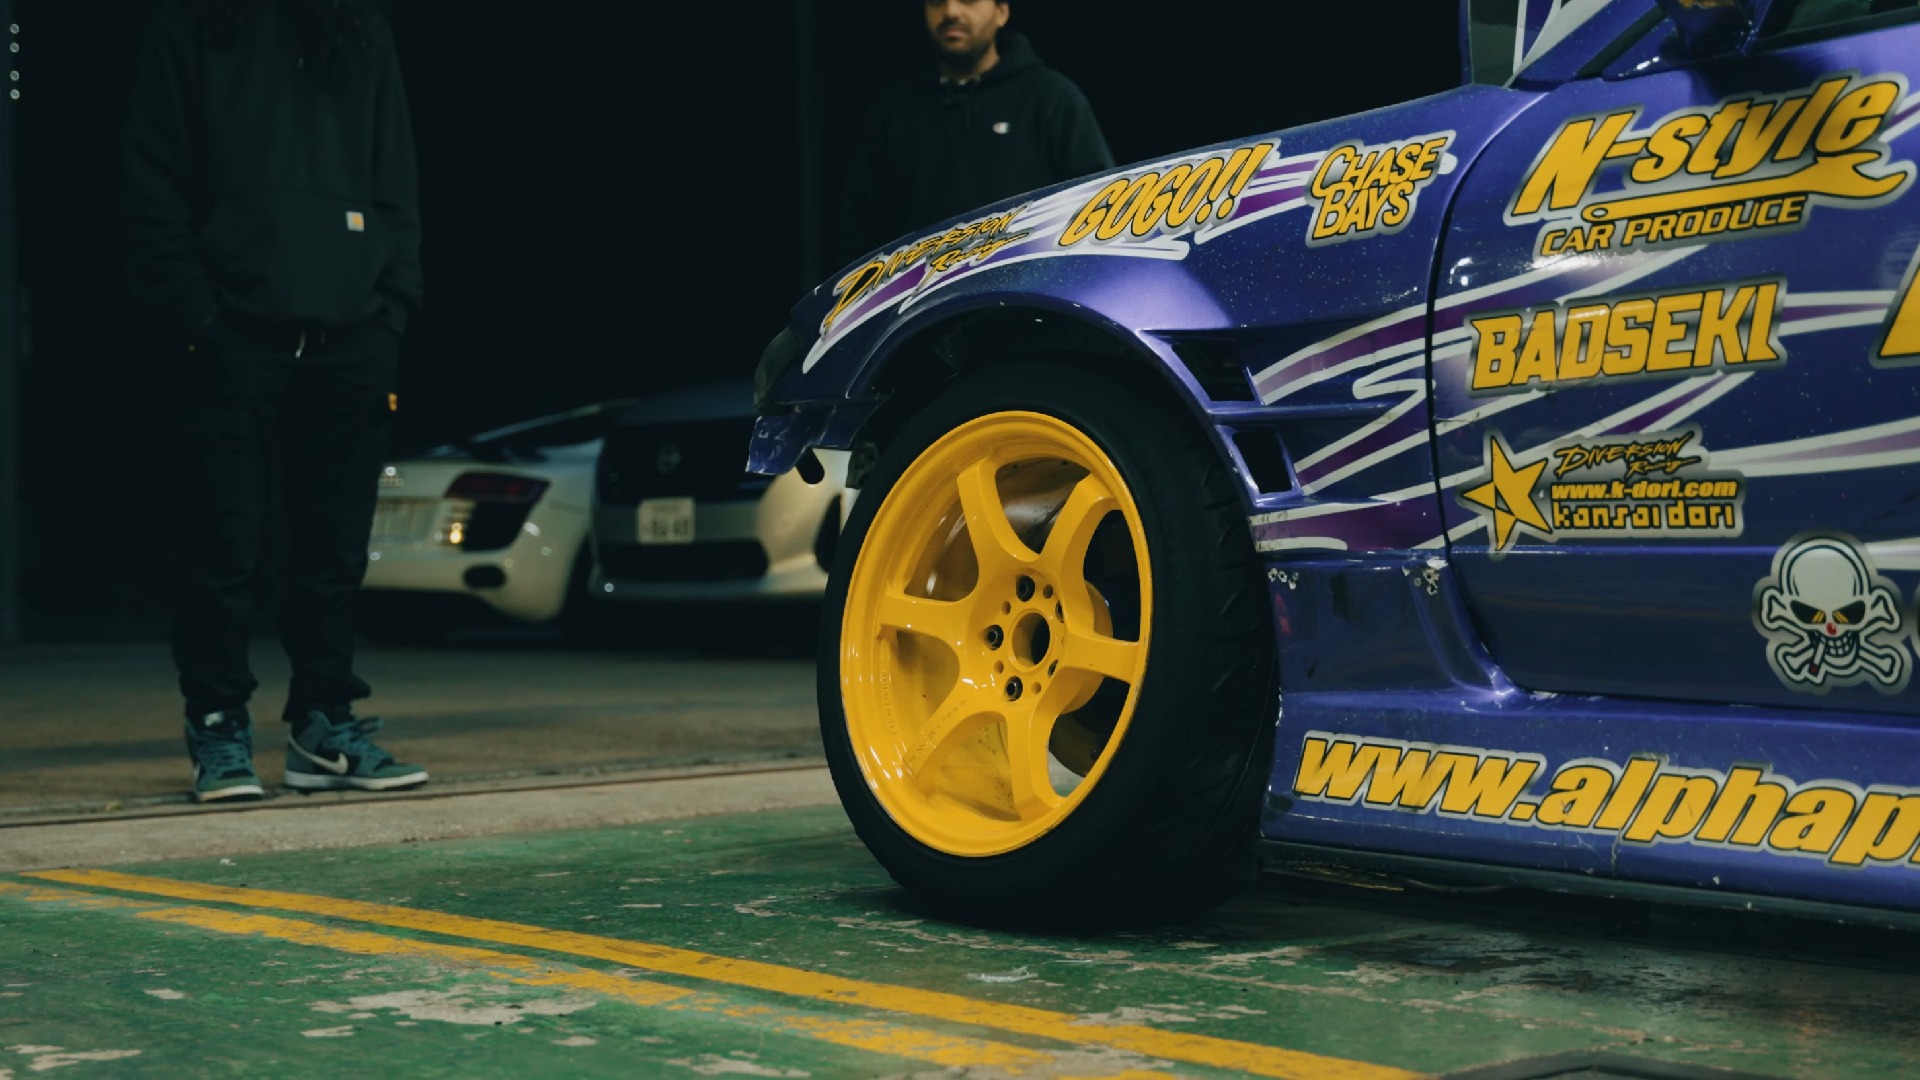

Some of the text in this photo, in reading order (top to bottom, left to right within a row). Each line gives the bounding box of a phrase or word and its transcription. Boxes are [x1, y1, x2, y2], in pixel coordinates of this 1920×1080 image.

[1311, 137, 1448, 197] CHASE
[1513, 75, 1901, 216] N-style
[1058, 144, 1274, 247] GOGO!!
[1312, 179, 1416, 240] BAYS
[1540, 196, 1805, 257] CAR PRODUCE
[1470, 283, 1780, 390] BADSEKI
[1551, 479, 1738, 499] www.k-dori.com
[1293, 736, 1920, 865] www.alphap
